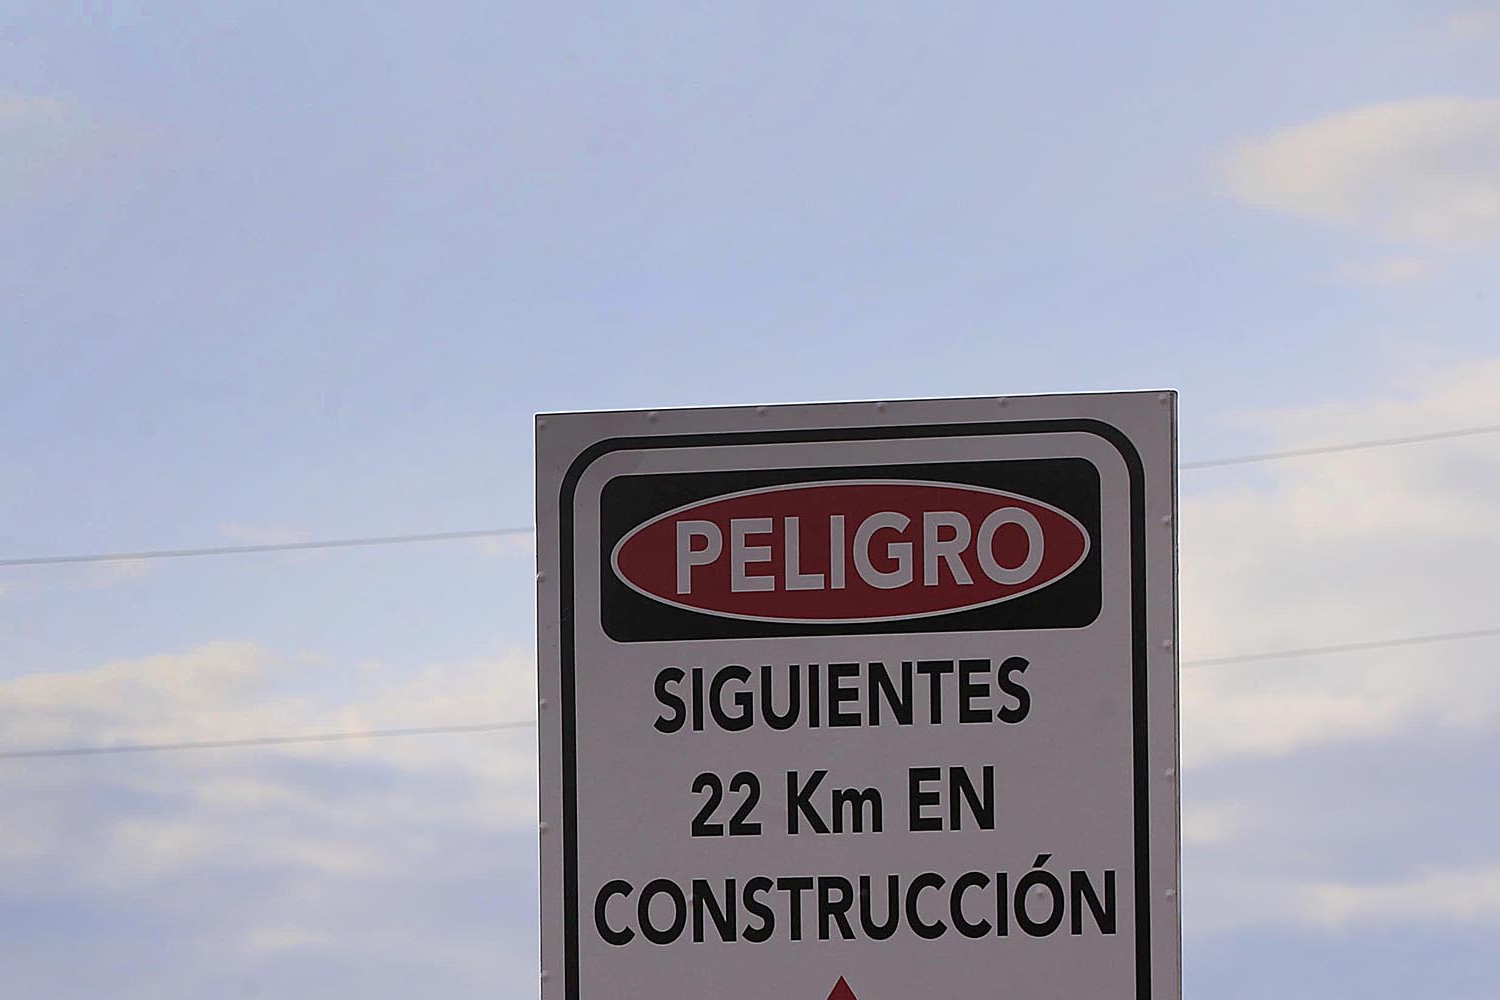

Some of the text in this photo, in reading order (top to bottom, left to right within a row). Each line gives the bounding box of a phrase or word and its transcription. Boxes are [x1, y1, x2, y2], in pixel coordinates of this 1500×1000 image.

[675, 506, 1046, 596] PELIGRO
[653, 656, 1032, 734] SIGUIENTES
[691, 765, 995, 838] 22 Km EN
[594, 853, 1118, 946] CONSTRUCCIÓN
